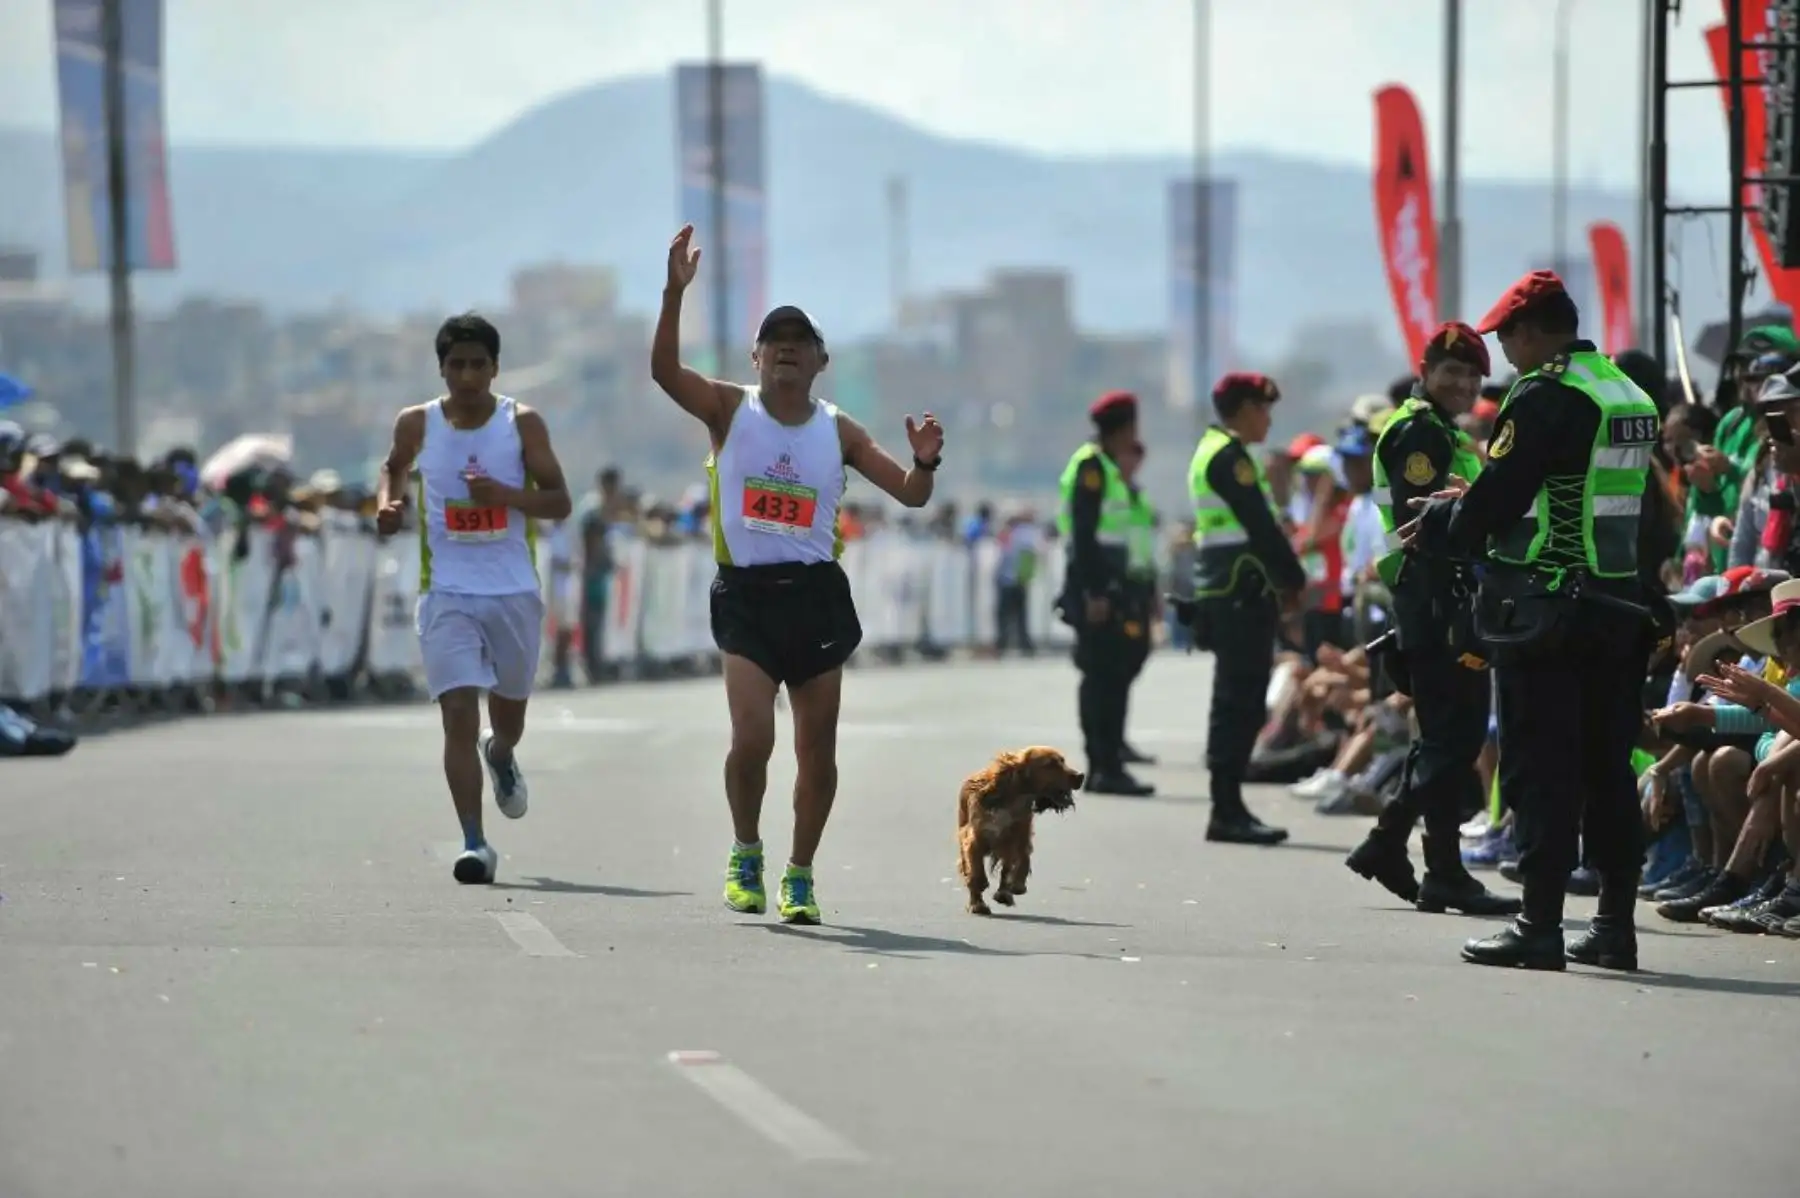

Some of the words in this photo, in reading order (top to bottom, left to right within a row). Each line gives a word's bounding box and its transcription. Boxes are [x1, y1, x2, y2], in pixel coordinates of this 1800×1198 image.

[1622, 418, 1654, 440] USE
[752, 494, 800, 522] 433
[455, 510, 494, 531] 591
